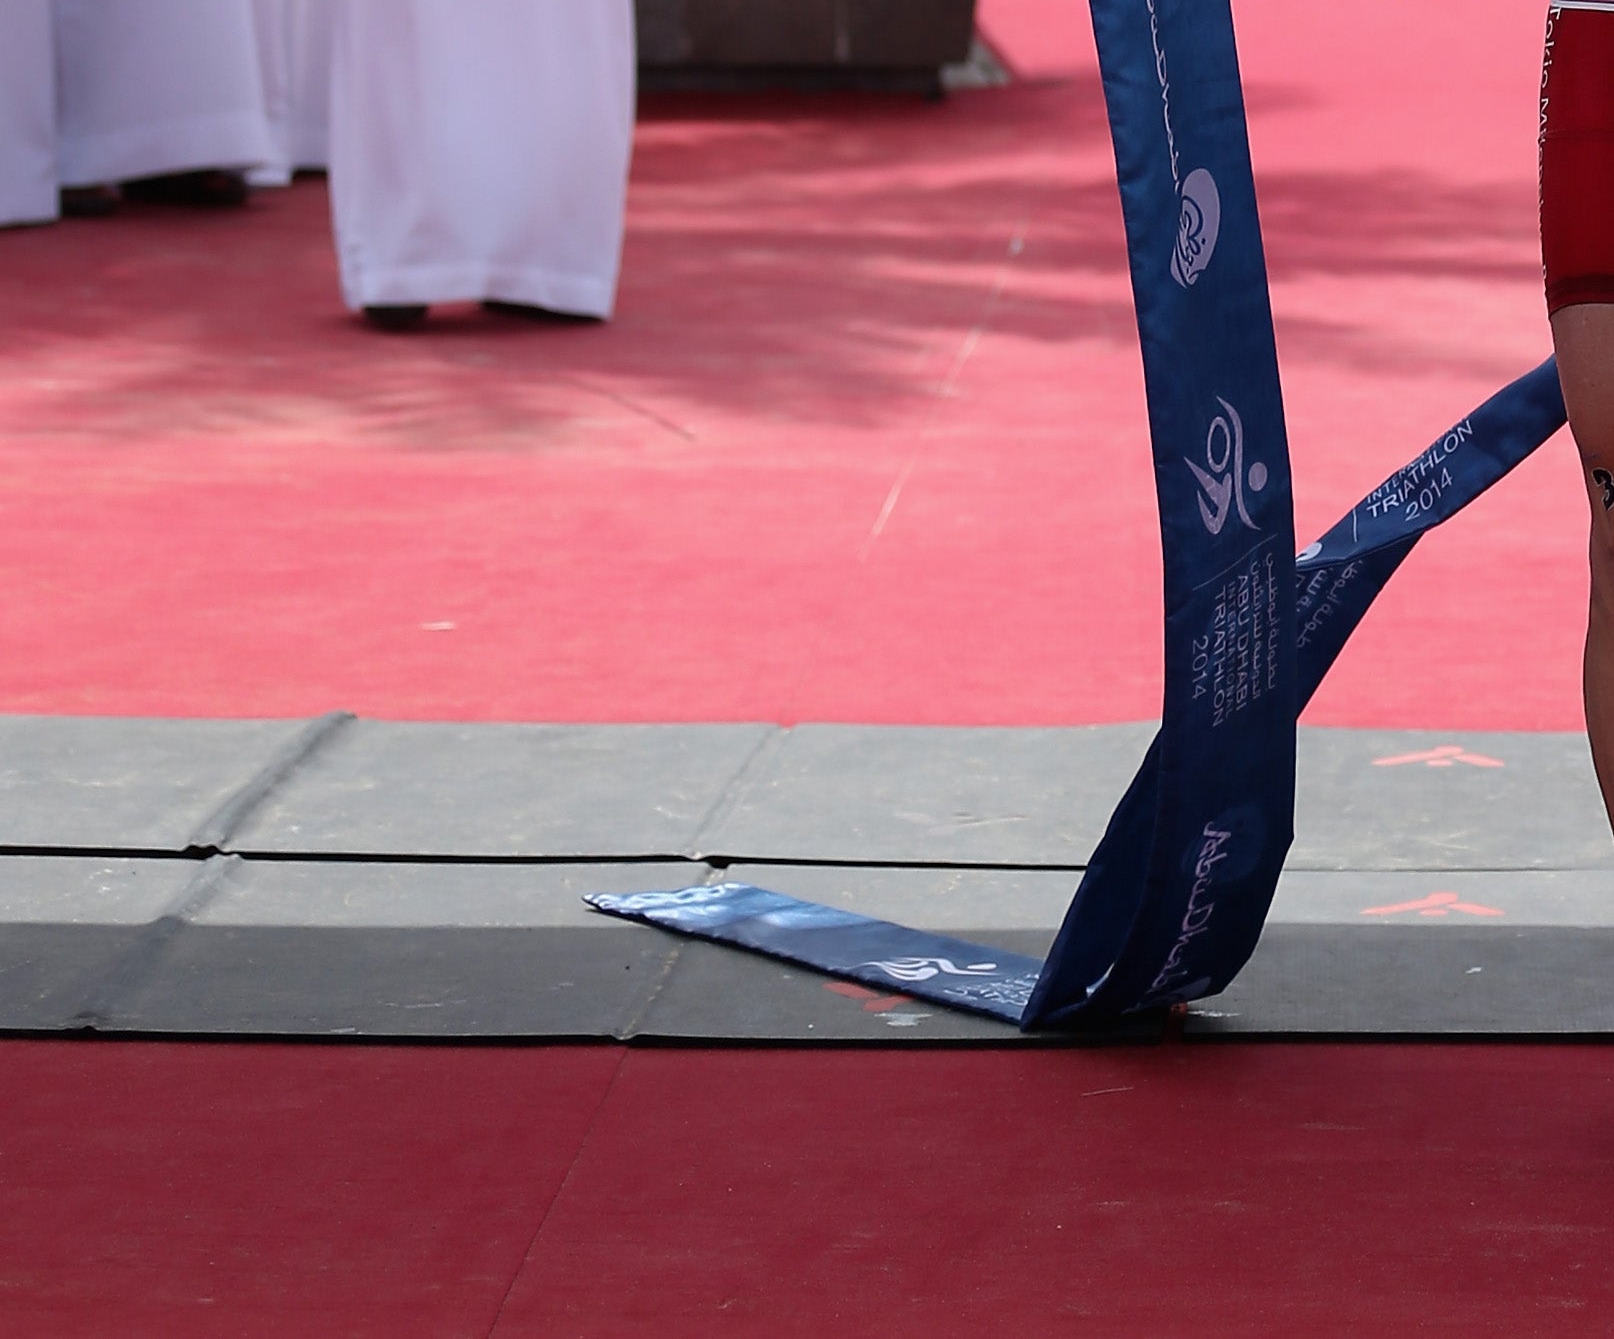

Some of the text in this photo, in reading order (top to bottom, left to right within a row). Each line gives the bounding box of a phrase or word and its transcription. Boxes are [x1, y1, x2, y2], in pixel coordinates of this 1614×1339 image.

[1366, 419, 1474, 518] TRIATHLON
[1404, 467, 1454, 522] 2014
[1192, 635, 1208, 700] 2014
[1212, 585, 1227, 727] TRIATHLON
[1236, 575, 1249, 711] ABU DHABI
